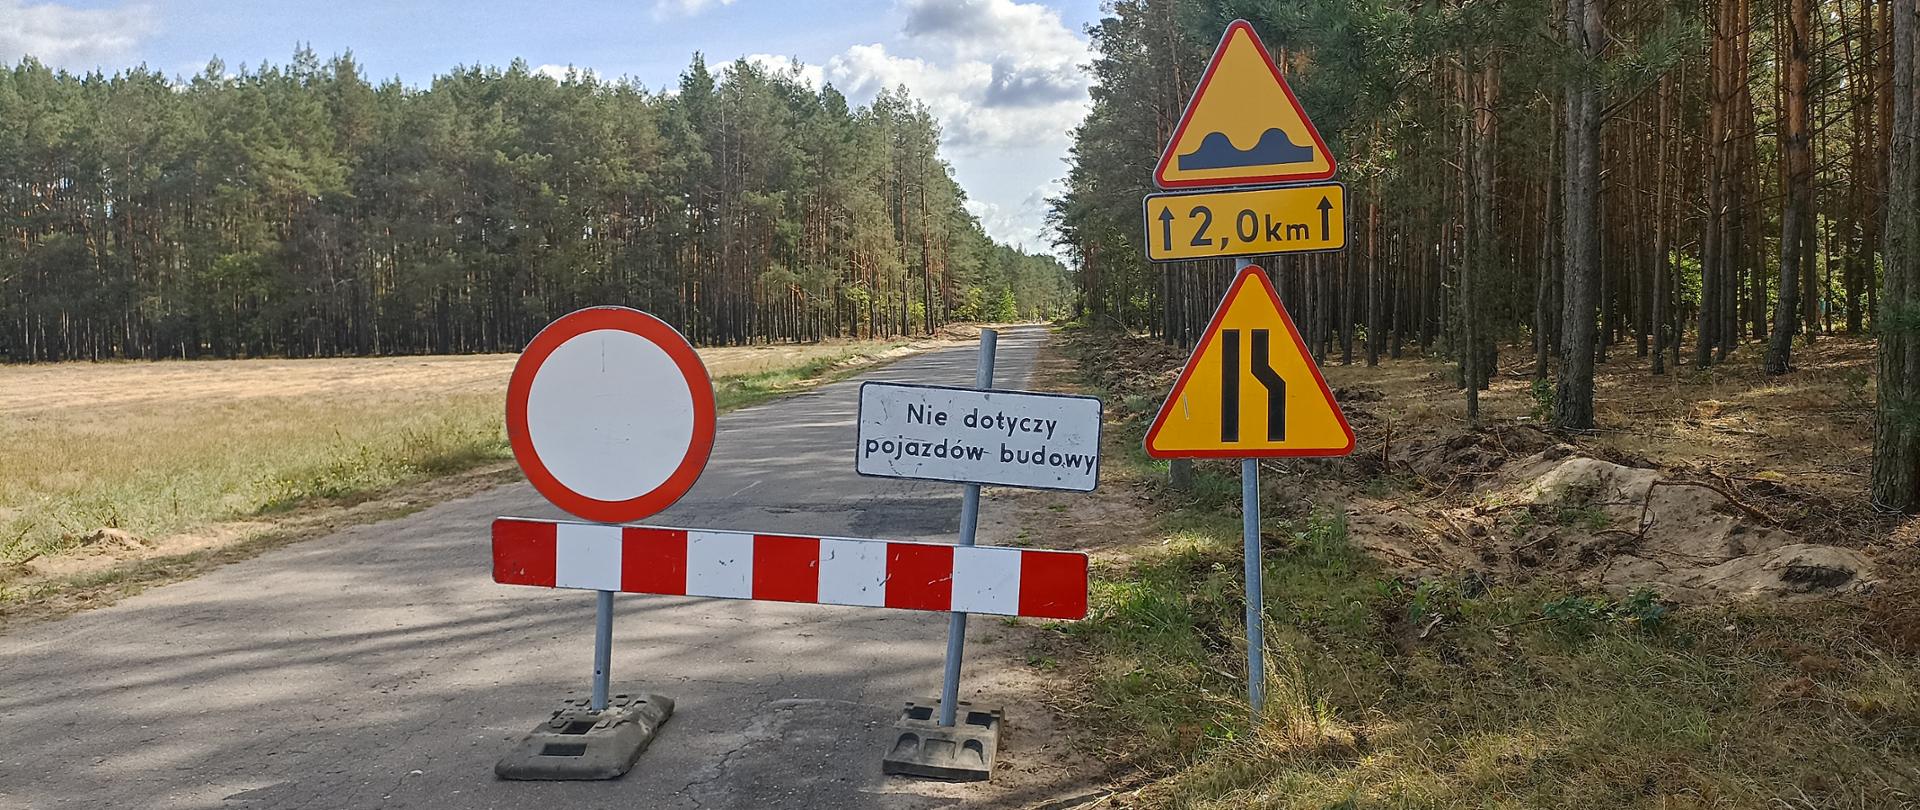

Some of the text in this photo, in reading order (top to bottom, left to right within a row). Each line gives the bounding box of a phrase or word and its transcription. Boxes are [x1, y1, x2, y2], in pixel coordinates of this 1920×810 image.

[907, 403, 1058, 440] Nie dotyczy
[865, 434, 1096, 476] pojazdów budowy
